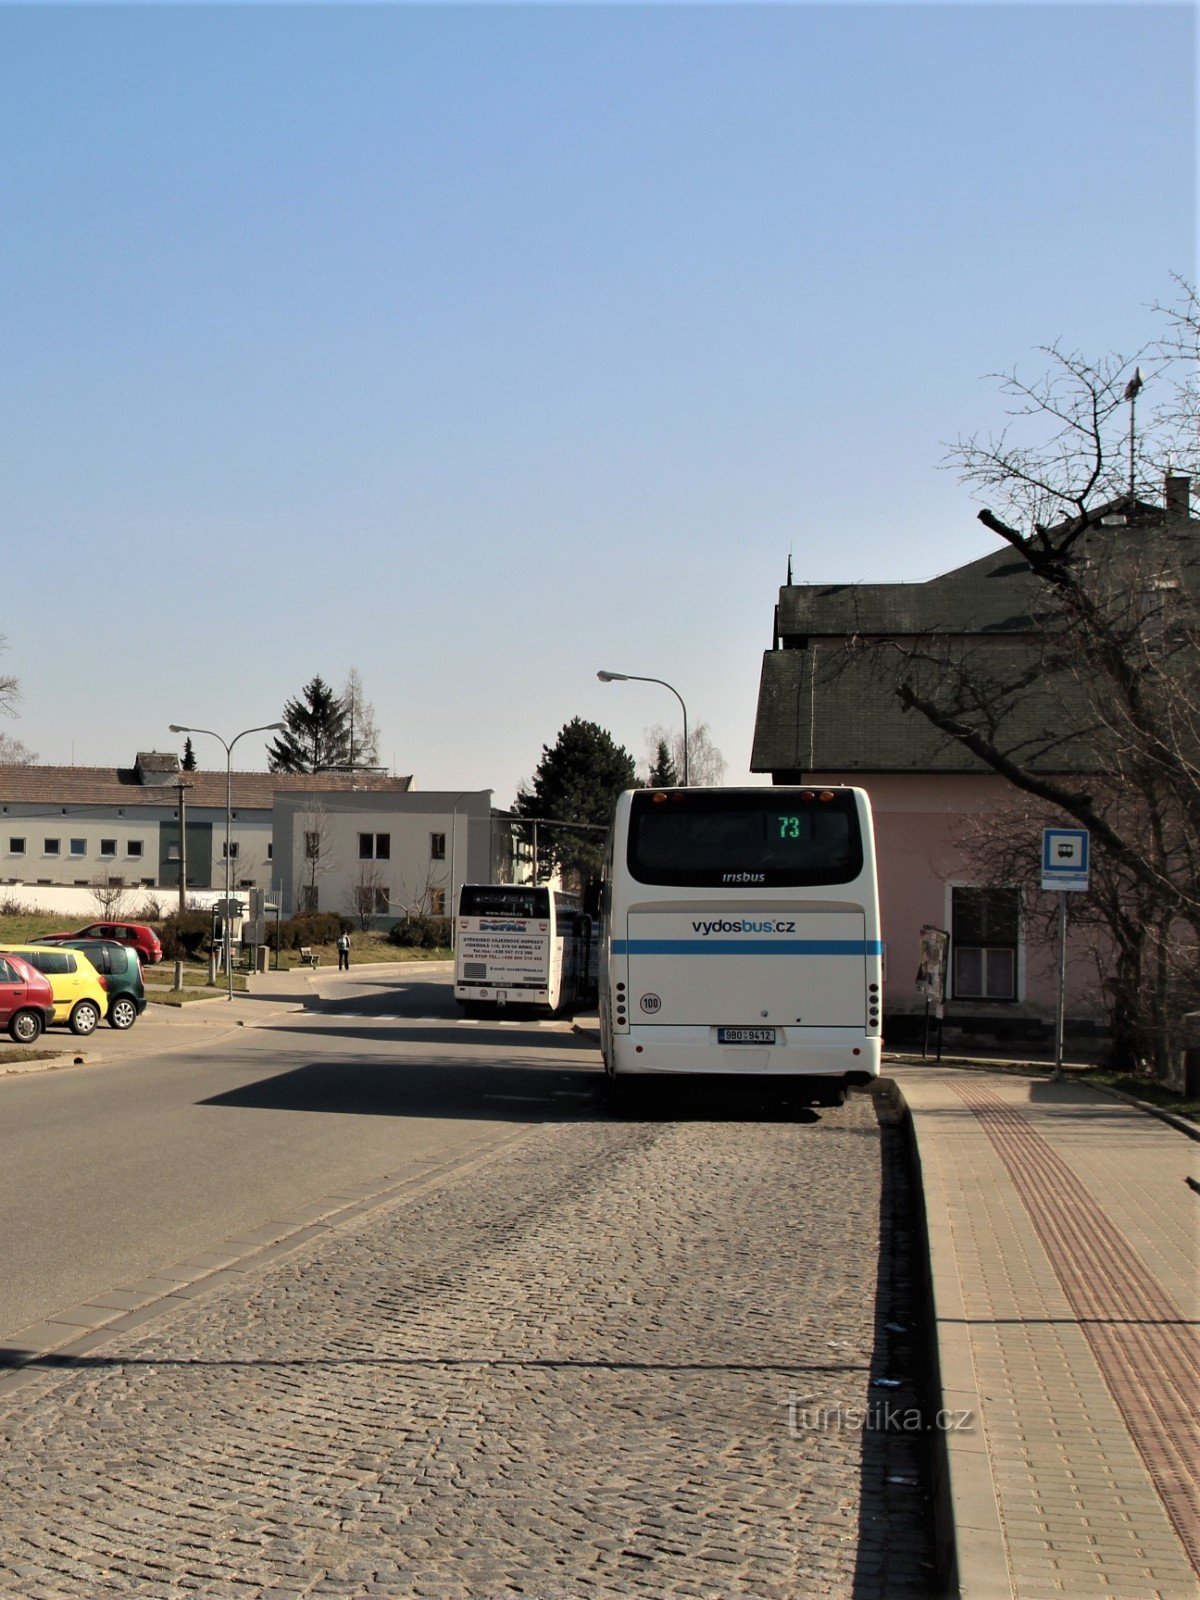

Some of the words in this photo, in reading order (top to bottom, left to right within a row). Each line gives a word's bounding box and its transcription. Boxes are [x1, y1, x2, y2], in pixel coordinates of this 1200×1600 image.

[778, 816, 800, 837] 73
[692, 919, 796, 935] vydosbus.cz
[643, 998, 658, 1008] 100
